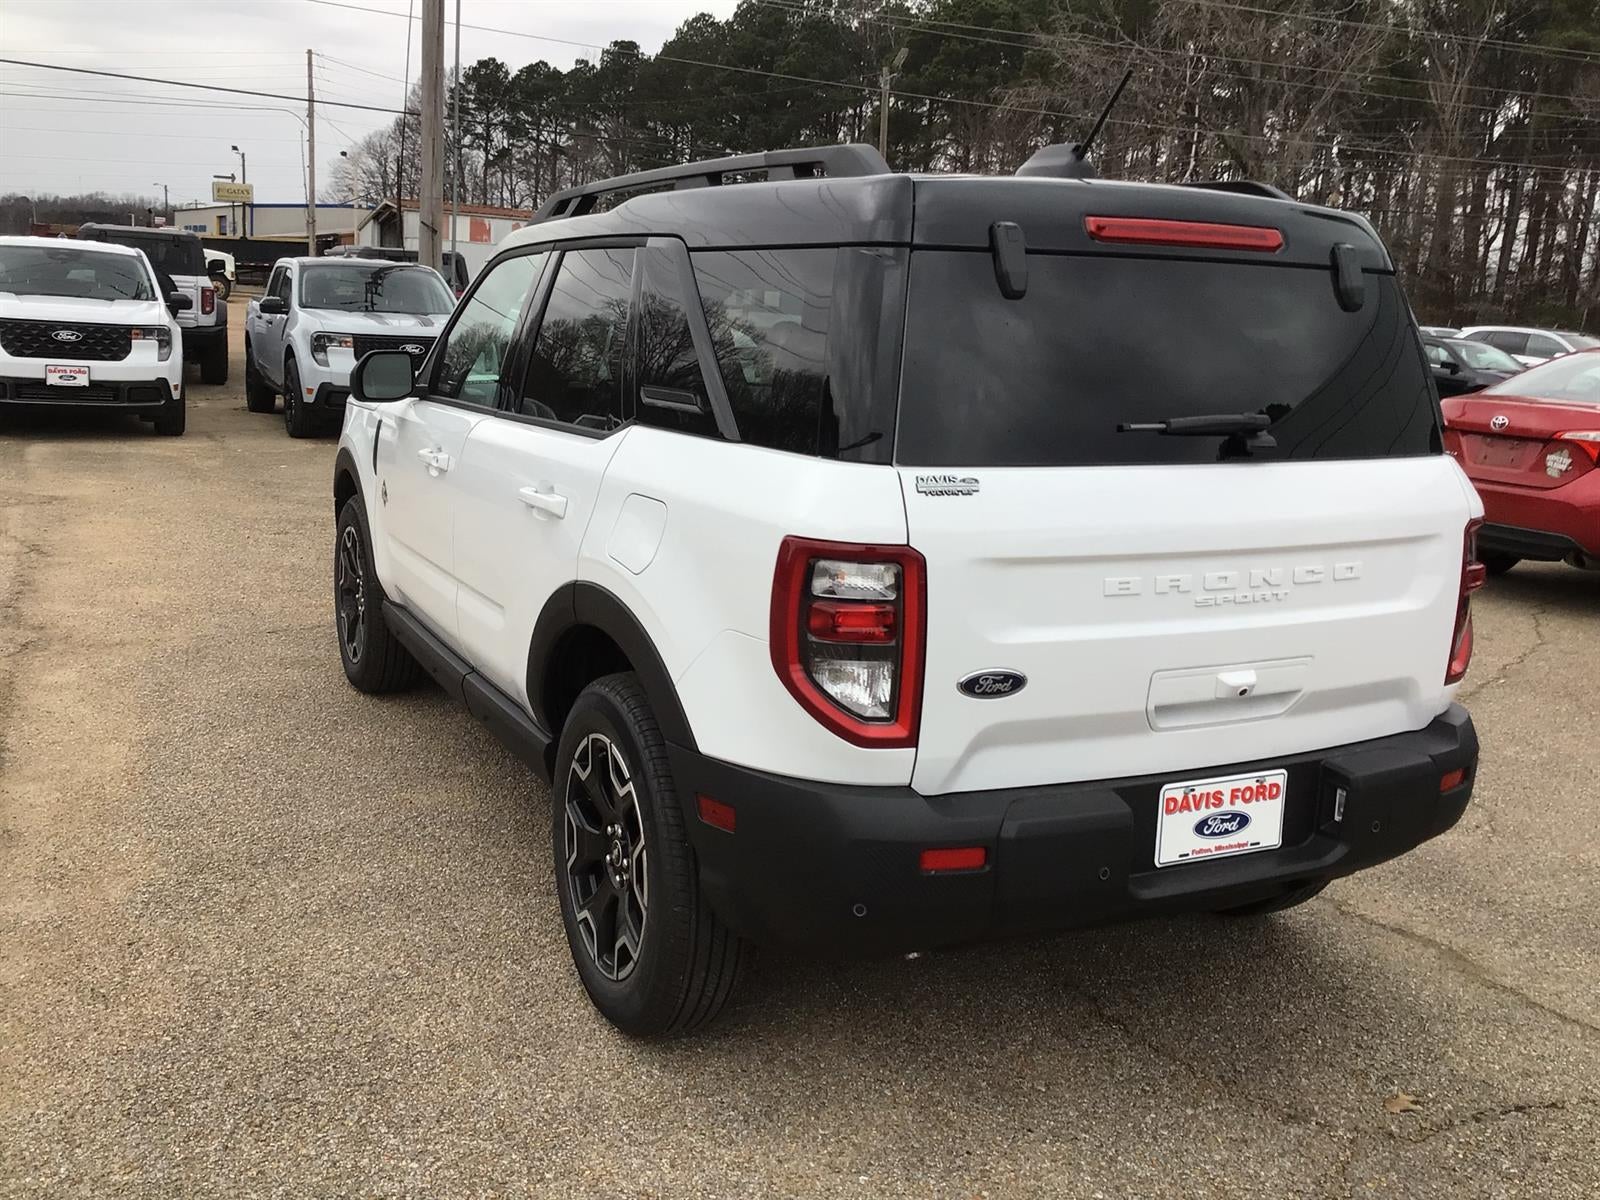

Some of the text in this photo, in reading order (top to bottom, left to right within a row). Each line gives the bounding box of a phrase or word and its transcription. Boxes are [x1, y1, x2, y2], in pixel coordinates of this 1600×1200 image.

[915, 475, 958, 485] DAVIS
[1103, 560, 1362, 597] BRONCO
[1194, 590, 1290, 607] SPORT
[974, 675, 1013, 693] Ford
[1165, 783, 1281, 816] DAVIS FORD
[1203, 813, 1241, 835] Ford
[1214, 841, 1249, 853] Mississippi
